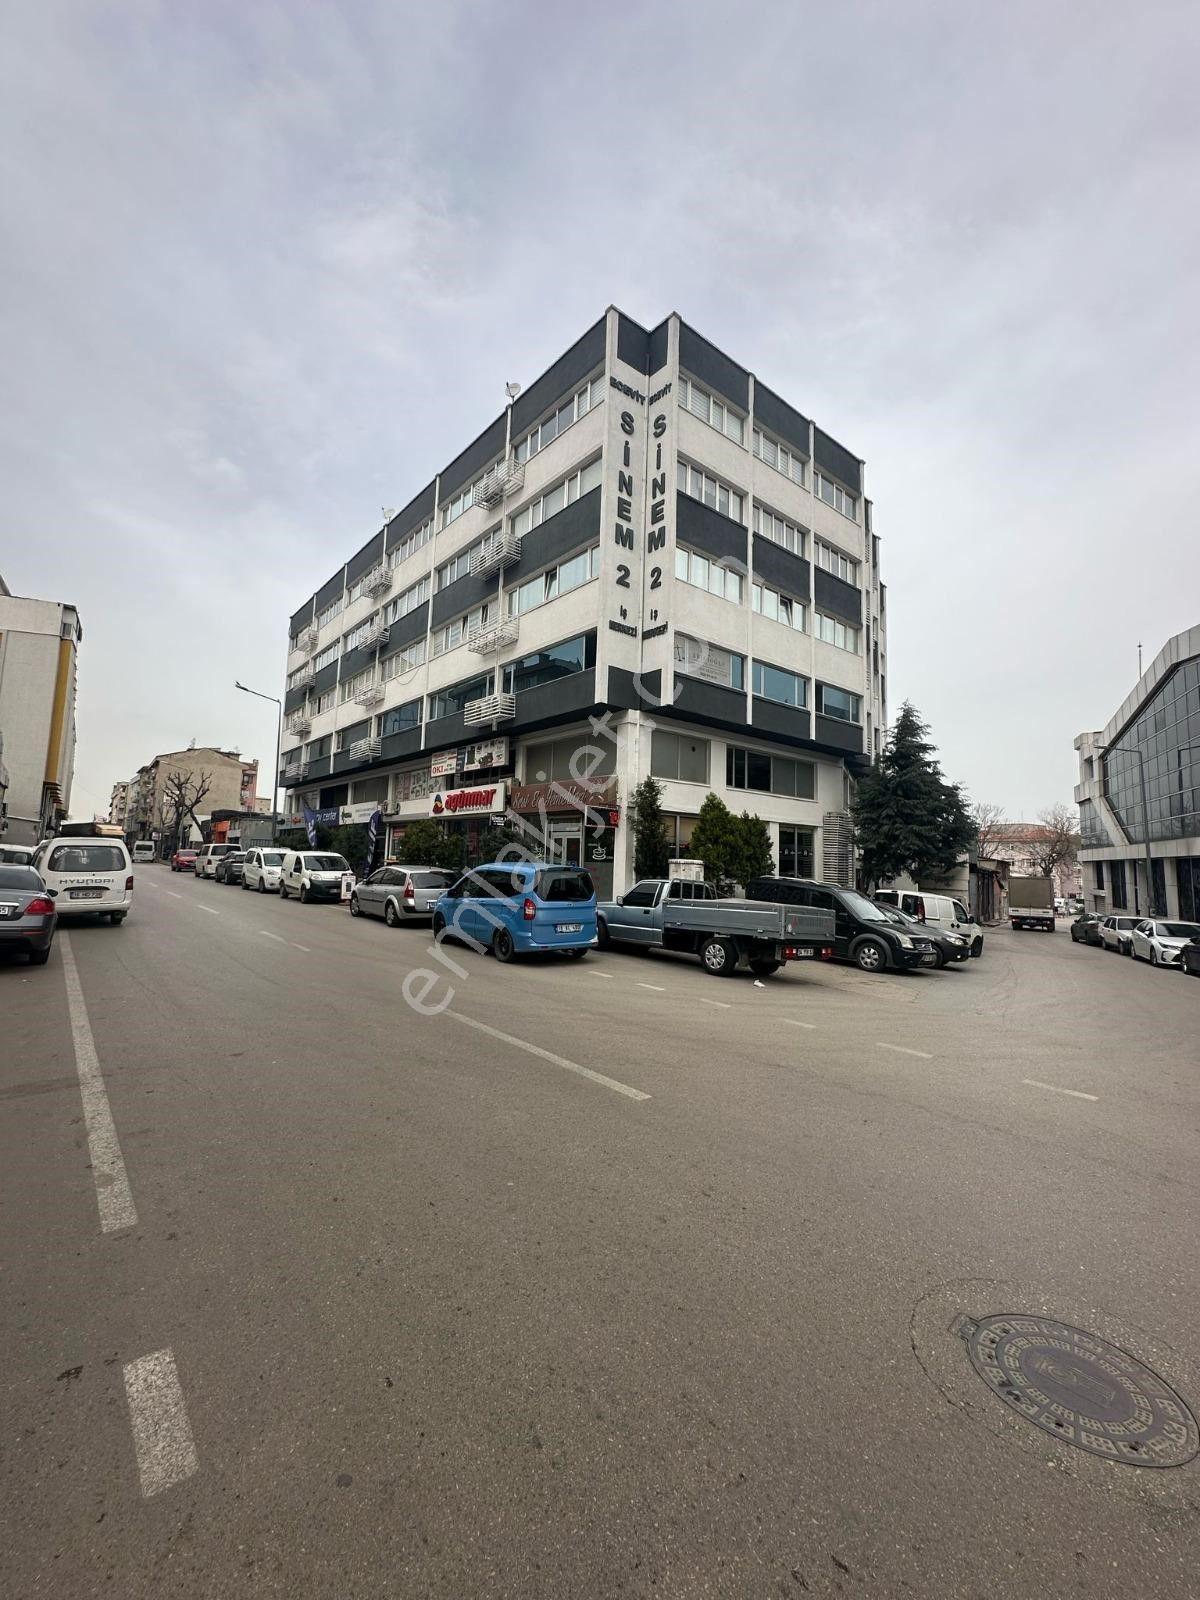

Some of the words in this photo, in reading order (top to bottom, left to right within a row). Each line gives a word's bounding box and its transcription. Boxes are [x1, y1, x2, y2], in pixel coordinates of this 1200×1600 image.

[614, 411, 634, 551] SİNEM
[648, 413, 666, 554] SİNEM
[616, 564, 631, 589] 2
[650, 566, 662, 590] 2
